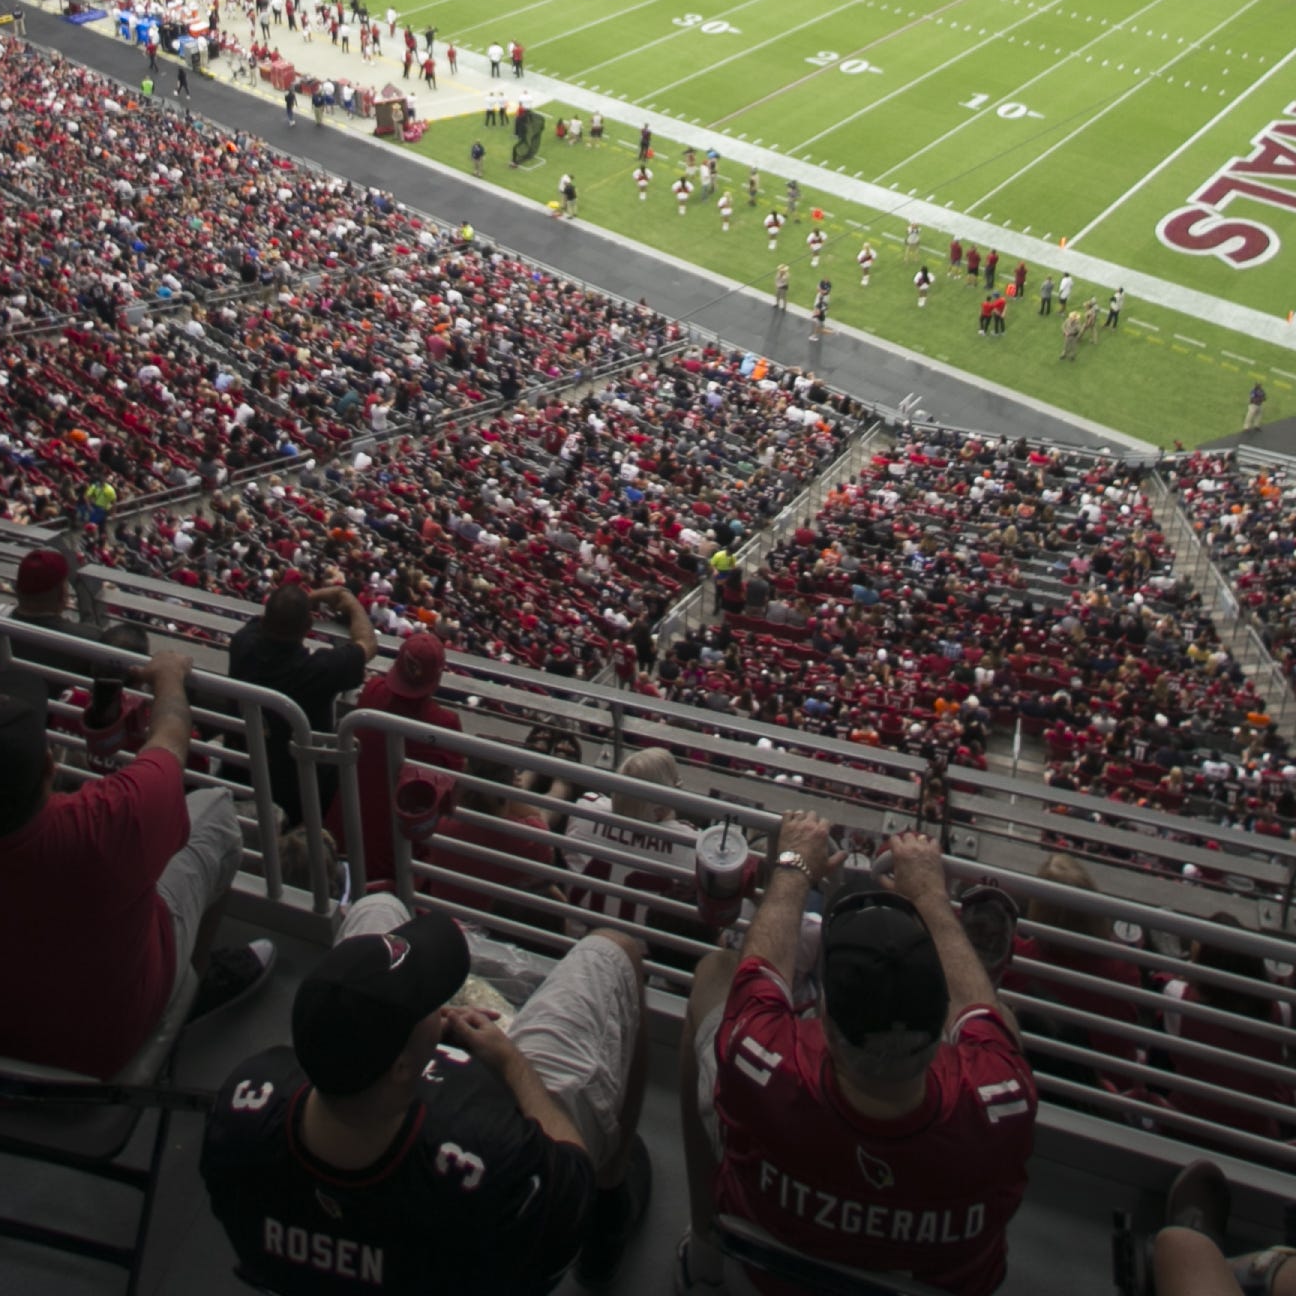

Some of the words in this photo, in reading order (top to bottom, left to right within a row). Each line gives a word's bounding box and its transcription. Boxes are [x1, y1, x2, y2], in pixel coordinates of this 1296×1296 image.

[671, 12, 731, 36] 30
[804, 50, 871, 76] 20
[958, 92, 1028, 120] 10
[591, 820, 675, 855] TILLMAN
[734, 1035, 783, 1087] 11
[231, 1077, 275, 1112] 3
[977, 1078, 1029, 1124] 11
[435, 1140, 486, 1192] 3
[758, 1159, 986, 1245] FITZGERALD
[263, 1215, 385, 1287] ROSEN
